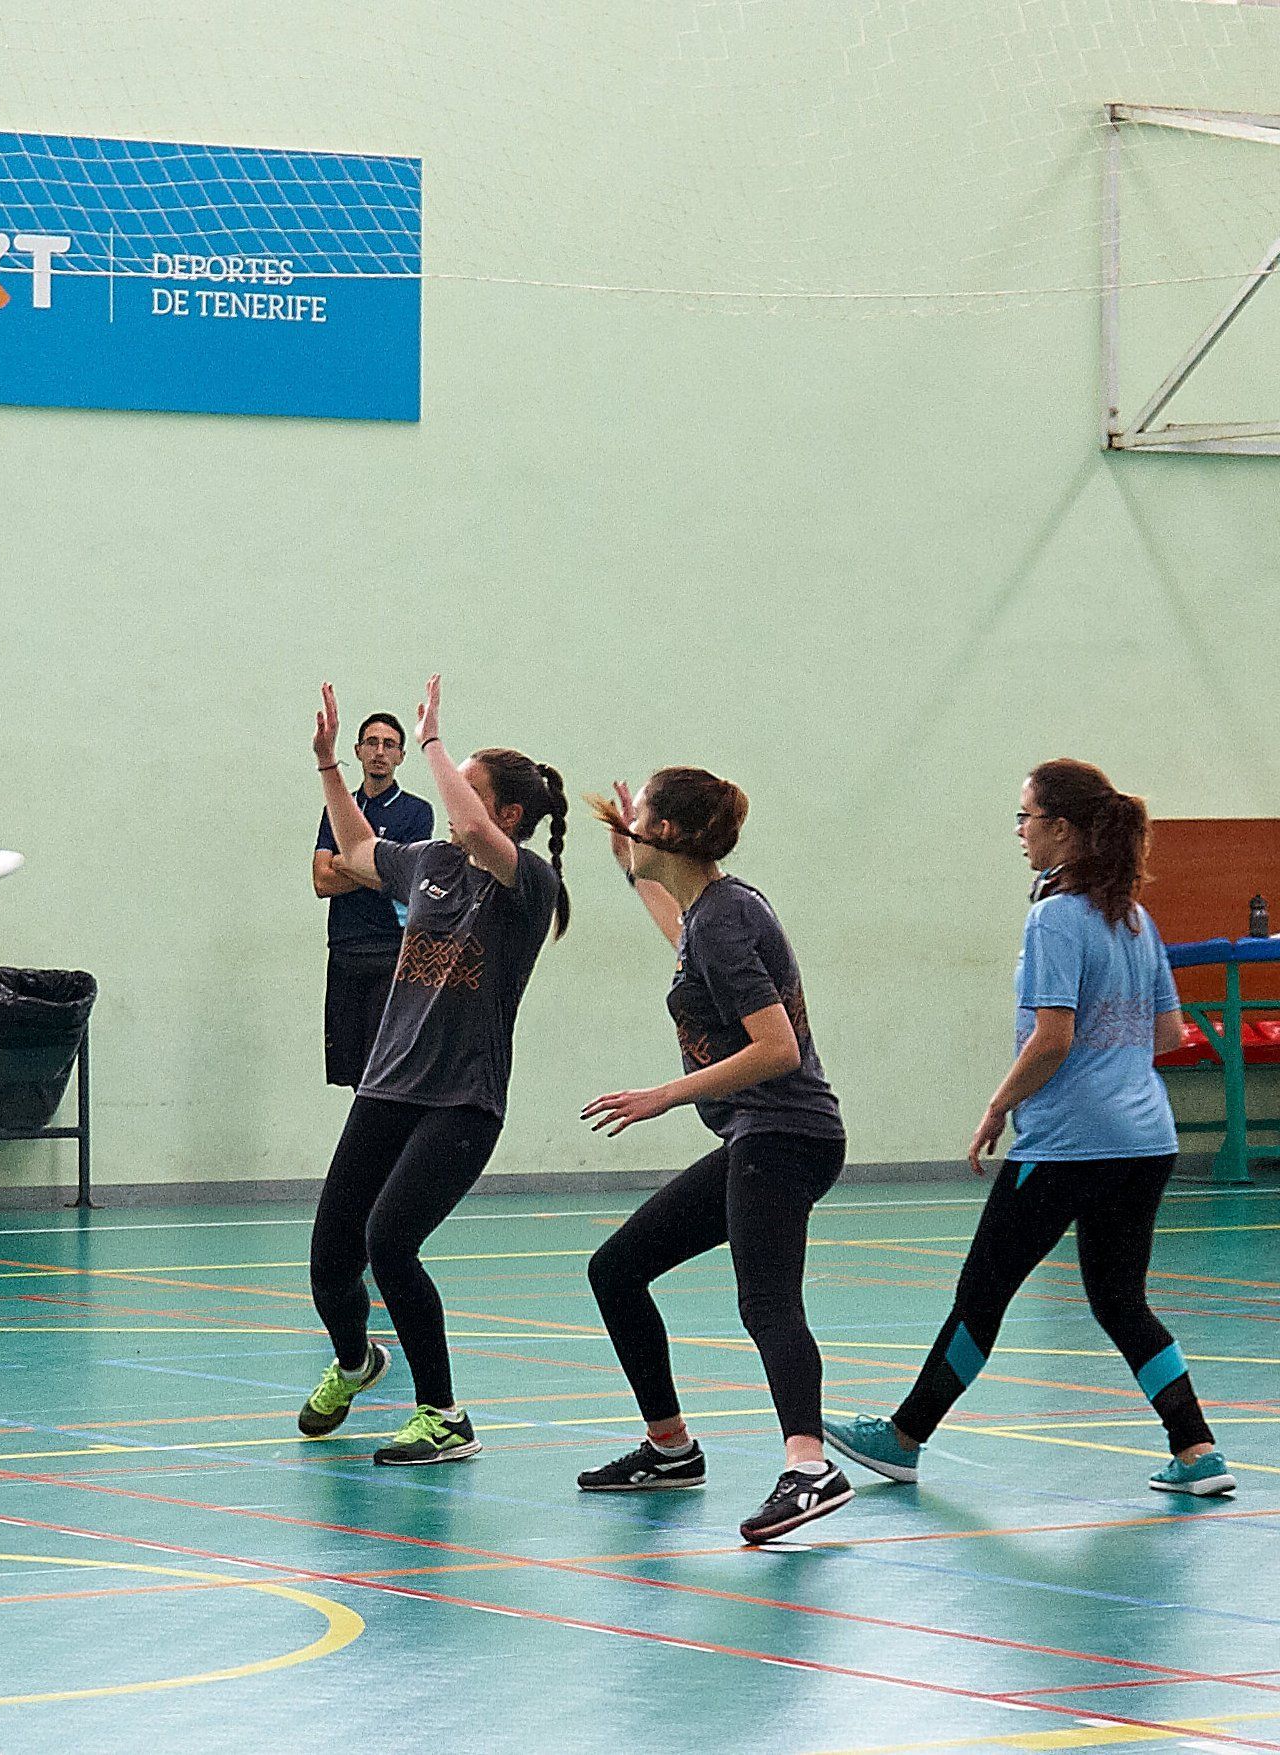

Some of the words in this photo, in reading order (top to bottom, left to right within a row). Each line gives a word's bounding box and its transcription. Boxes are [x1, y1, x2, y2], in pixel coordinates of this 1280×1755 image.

[152, 252, 294, 286] DEPORTES
[152, 288, 190, 316] DE
[195, 291, 327, 323] TENERIFE
